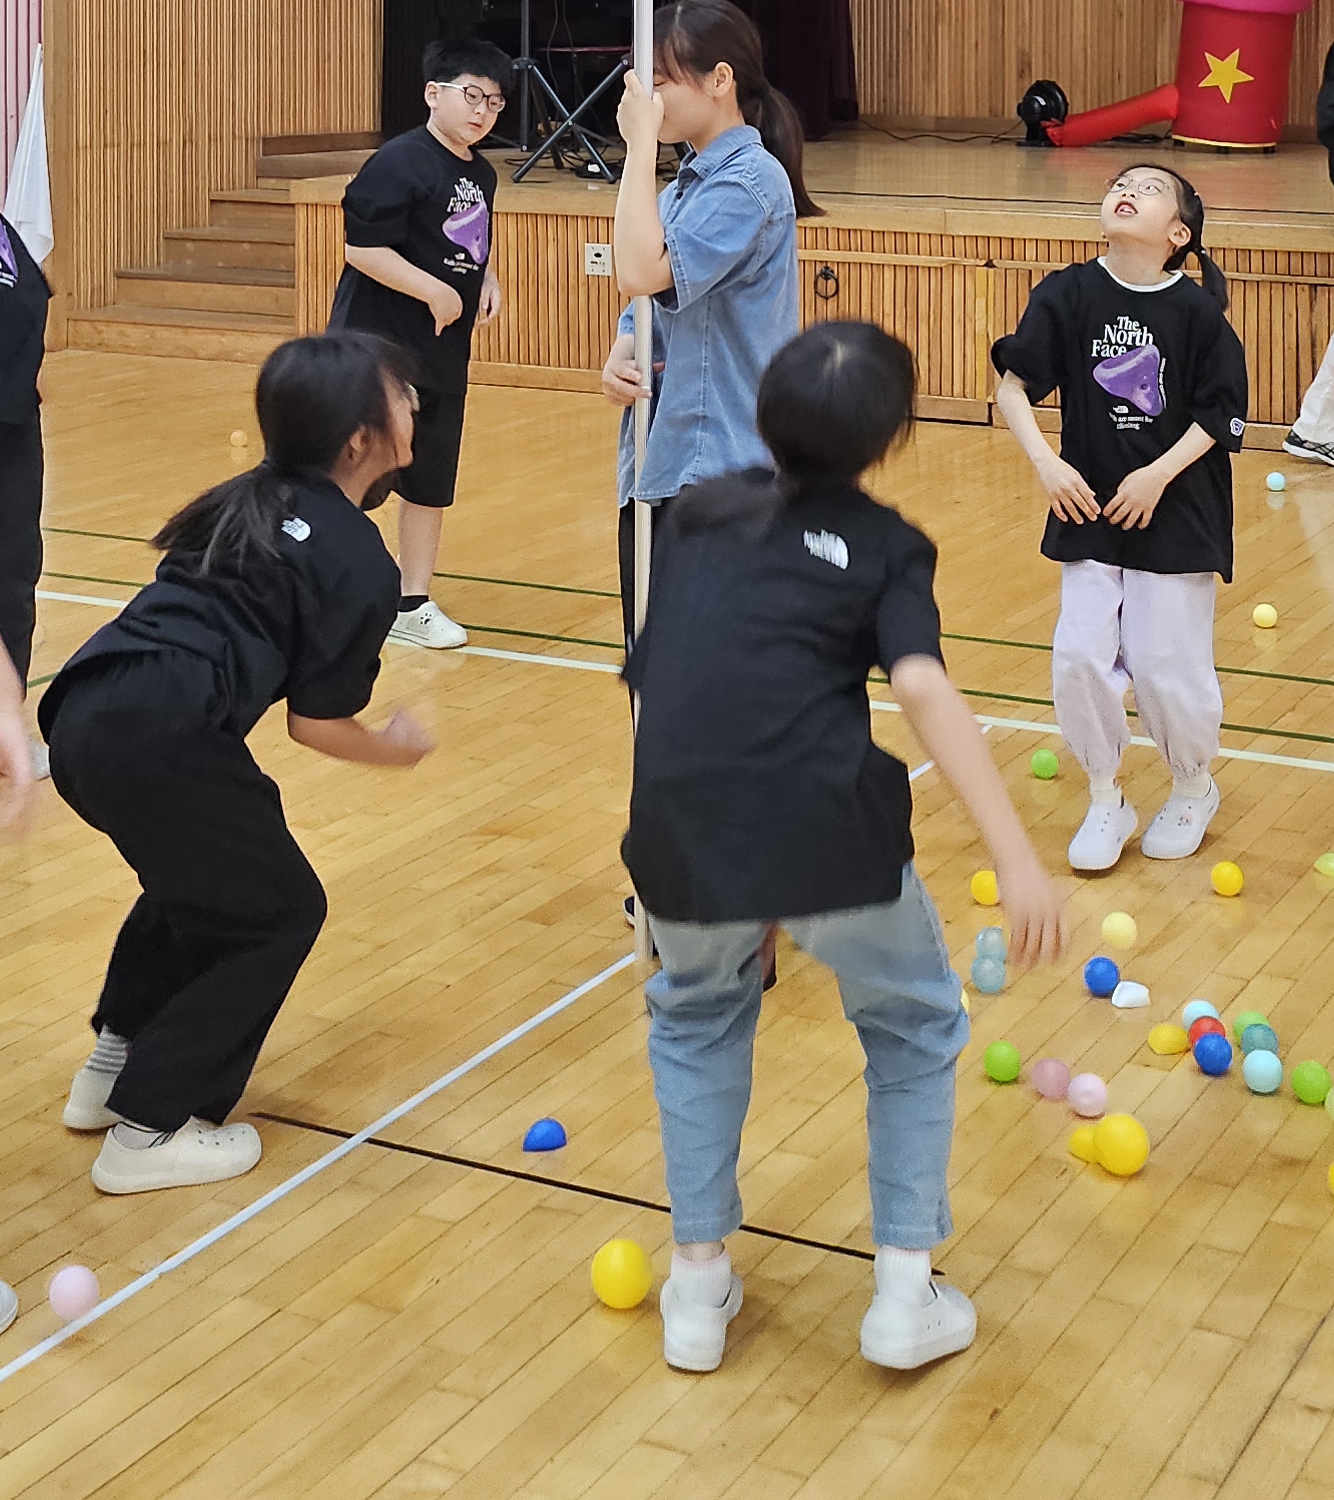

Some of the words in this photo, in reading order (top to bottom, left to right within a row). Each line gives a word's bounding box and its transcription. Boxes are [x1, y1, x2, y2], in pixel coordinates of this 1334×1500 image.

[1116, 315, 1141, 331] The
[1103, 323, 1154, 347] North
[1091, 339, 1128, 358] Face
